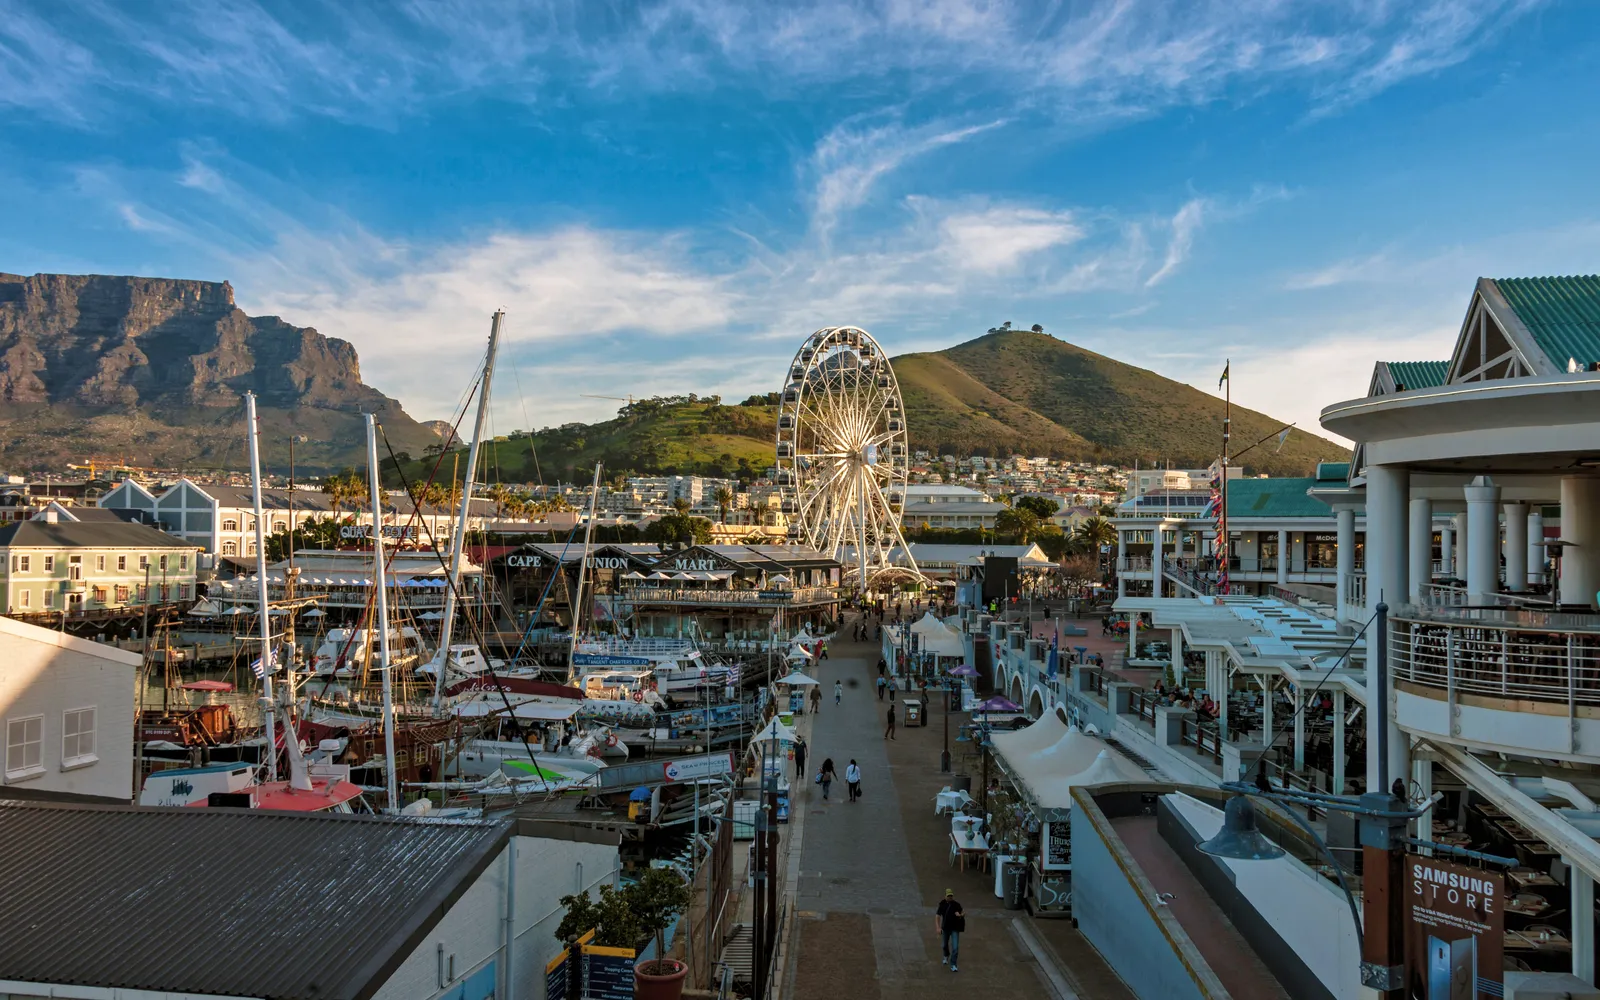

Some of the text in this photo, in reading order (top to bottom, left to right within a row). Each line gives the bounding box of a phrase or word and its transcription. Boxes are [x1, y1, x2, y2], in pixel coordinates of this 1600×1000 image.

[341, 526, 413, 539] QUAY FOUR
[508, 555, 716, 570] CAPE UNION MART
[1413, 864, 1494, 896] SAMSUNG
[1413, 880, 1494, 914] STORE
[1413, 911, 1434, 920] Samsung
[1436, 911, 1462, 922] Waterfront
[1478, 922, 1491, 930] latest
